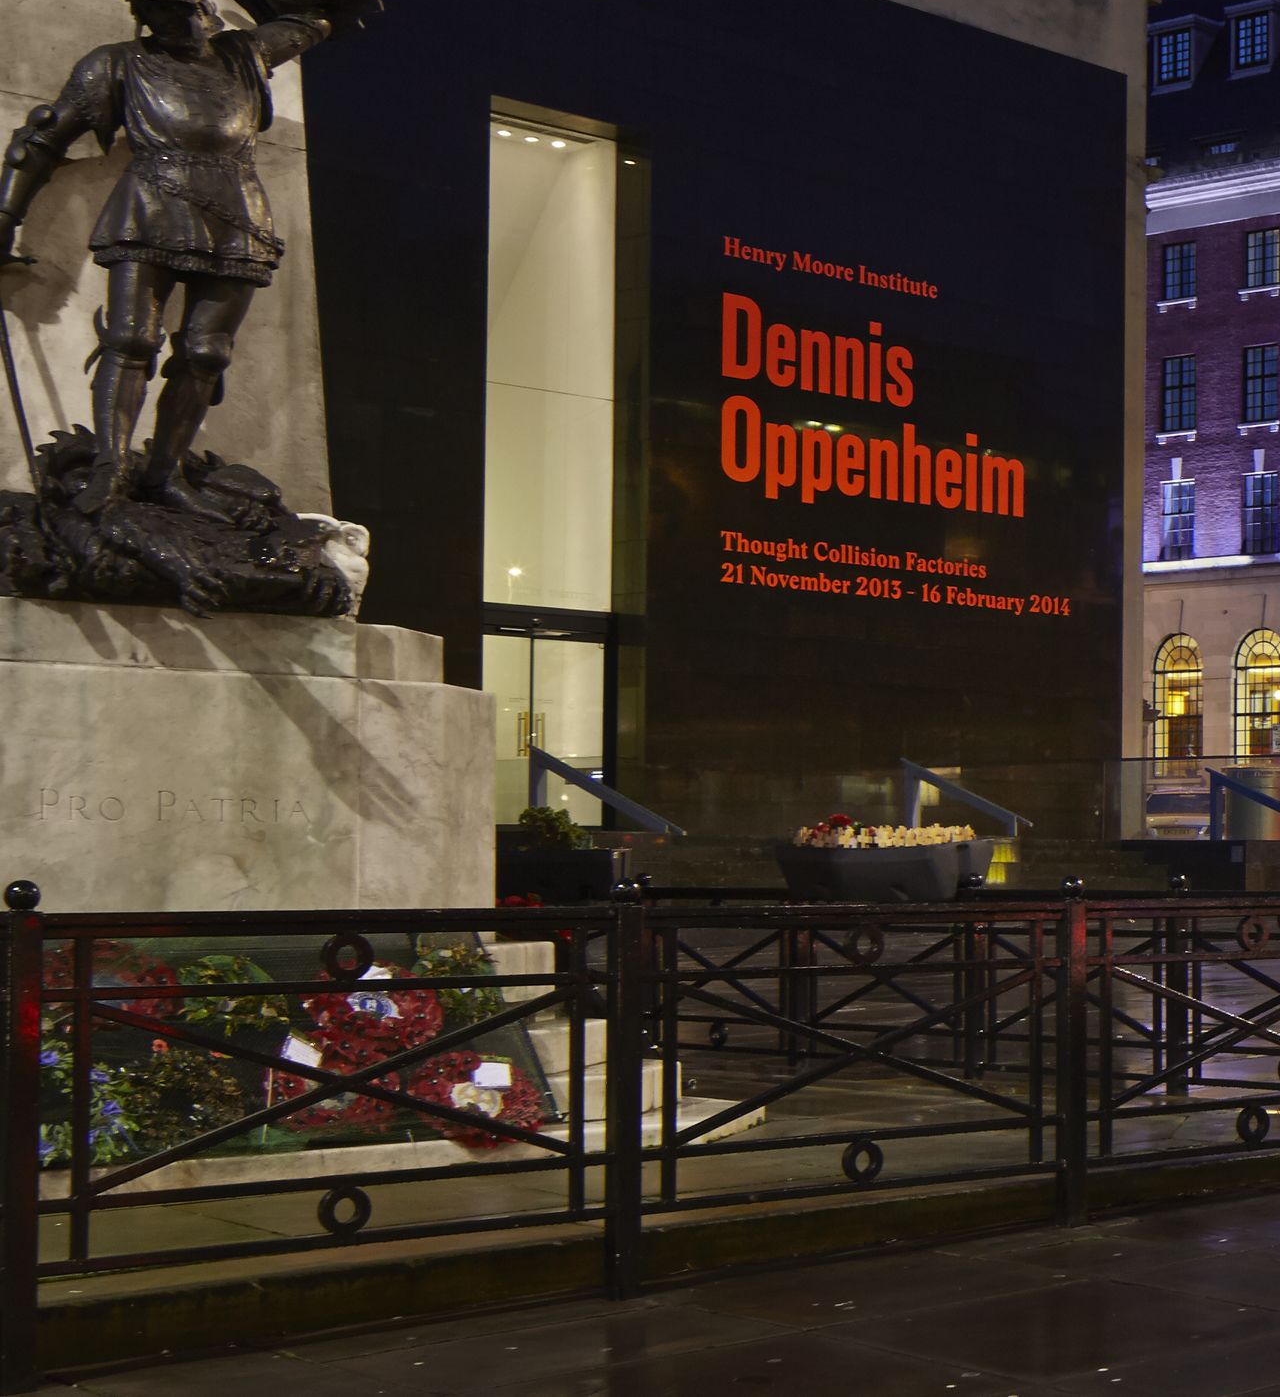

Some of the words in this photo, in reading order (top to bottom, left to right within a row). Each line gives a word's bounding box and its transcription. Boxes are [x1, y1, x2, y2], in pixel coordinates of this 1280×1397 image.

[723, 235, 787, 272] Henry
[793, 251, 854, 282] Moore
[859, 265, 938, 299] Institute
[721, 292, 914, 408] Dennis
[721, 395, 1025, 518] Oppenheim
[721, 531, 808, 562] Thought
[813, 541, 901, 570] Collision
[905, 552, 987, 579] Factories
[720, 561, 744, 584] 21
[750, 566, 851, 595] November
[855, 576, 902, 599] 2013
[921, 583, 941, 604] 16
[946, 586, 1025, 616] February
[1029, 595, 1071, 617] 2014
[38, 788, 126, 821] PRO
[156, 789, 312, 823] PATRIA
